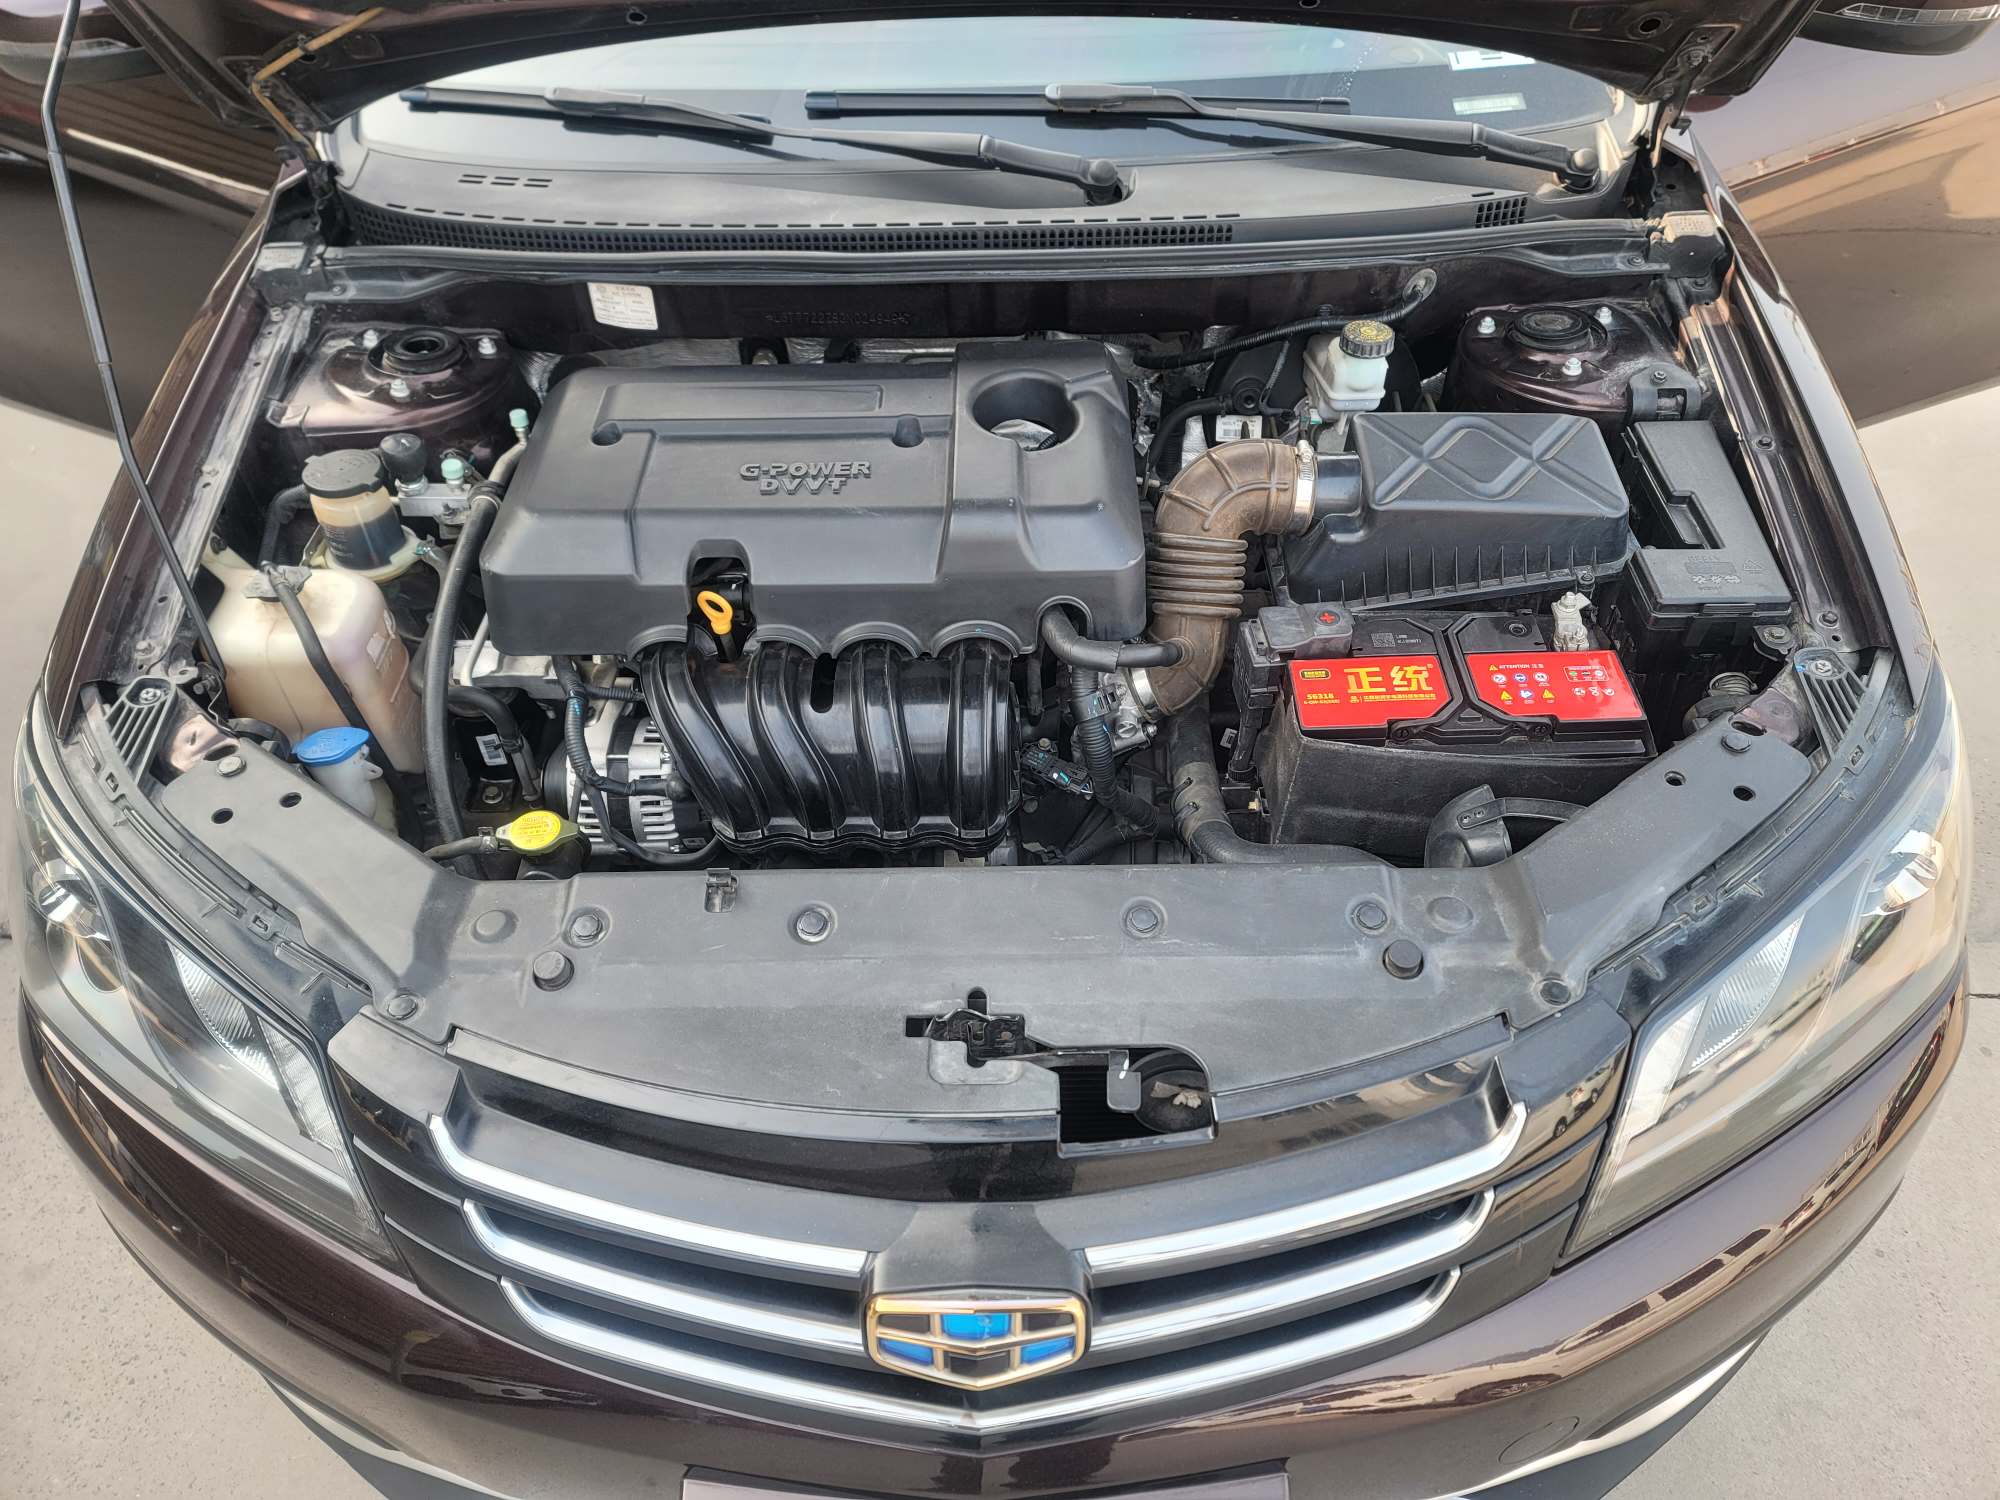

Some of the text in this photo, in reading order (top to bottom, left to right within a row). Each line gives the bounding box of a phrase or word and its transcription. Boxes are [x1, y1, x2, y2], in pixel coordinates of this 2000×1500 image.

[740, 461, 871, 480] G-POWER
[760, 477, 848, 495] DVVT
[1344, 665, 1433, 693] 正统
